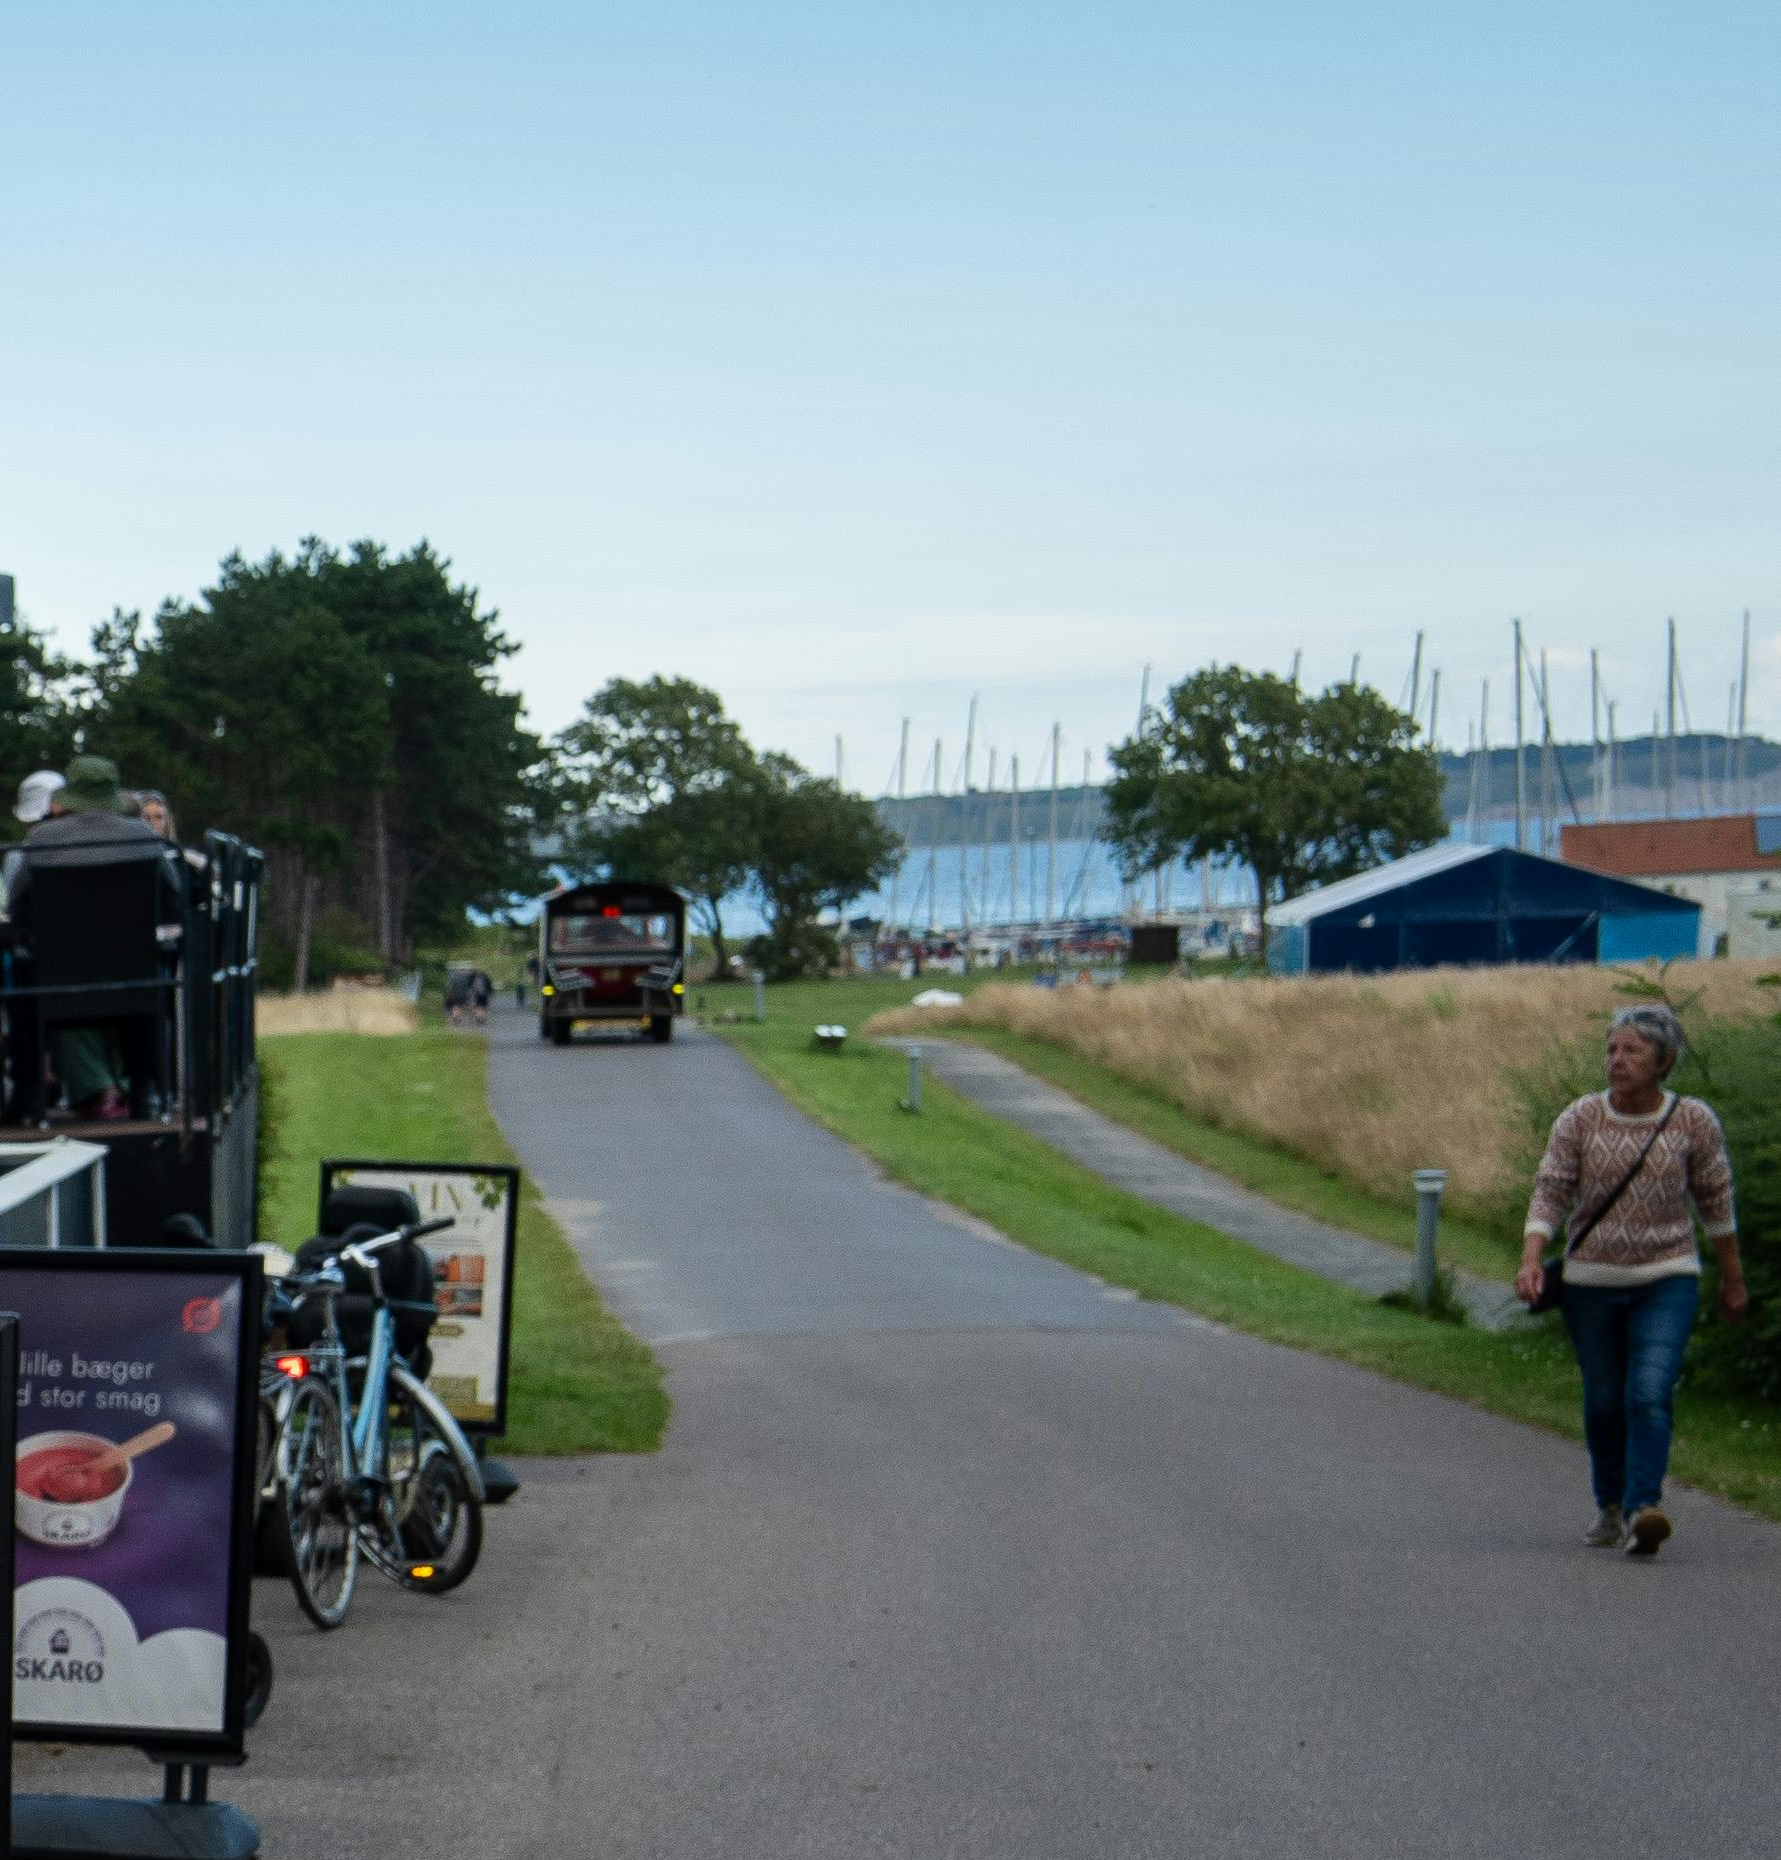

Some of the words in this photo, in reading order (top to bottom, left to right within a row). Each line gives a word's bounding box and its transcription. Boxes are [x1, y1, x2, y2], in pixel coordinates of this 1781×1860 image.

[19, 1350, 63, 1378] lille
[71, 1352, 156, 1386] bæger
[16, 1380, 32, 1408] d
[40, 1385, 87, 1409] stor
[95, 1390, 162, 1417] smag
[16, 1657, 105, 1683] SKARØ
